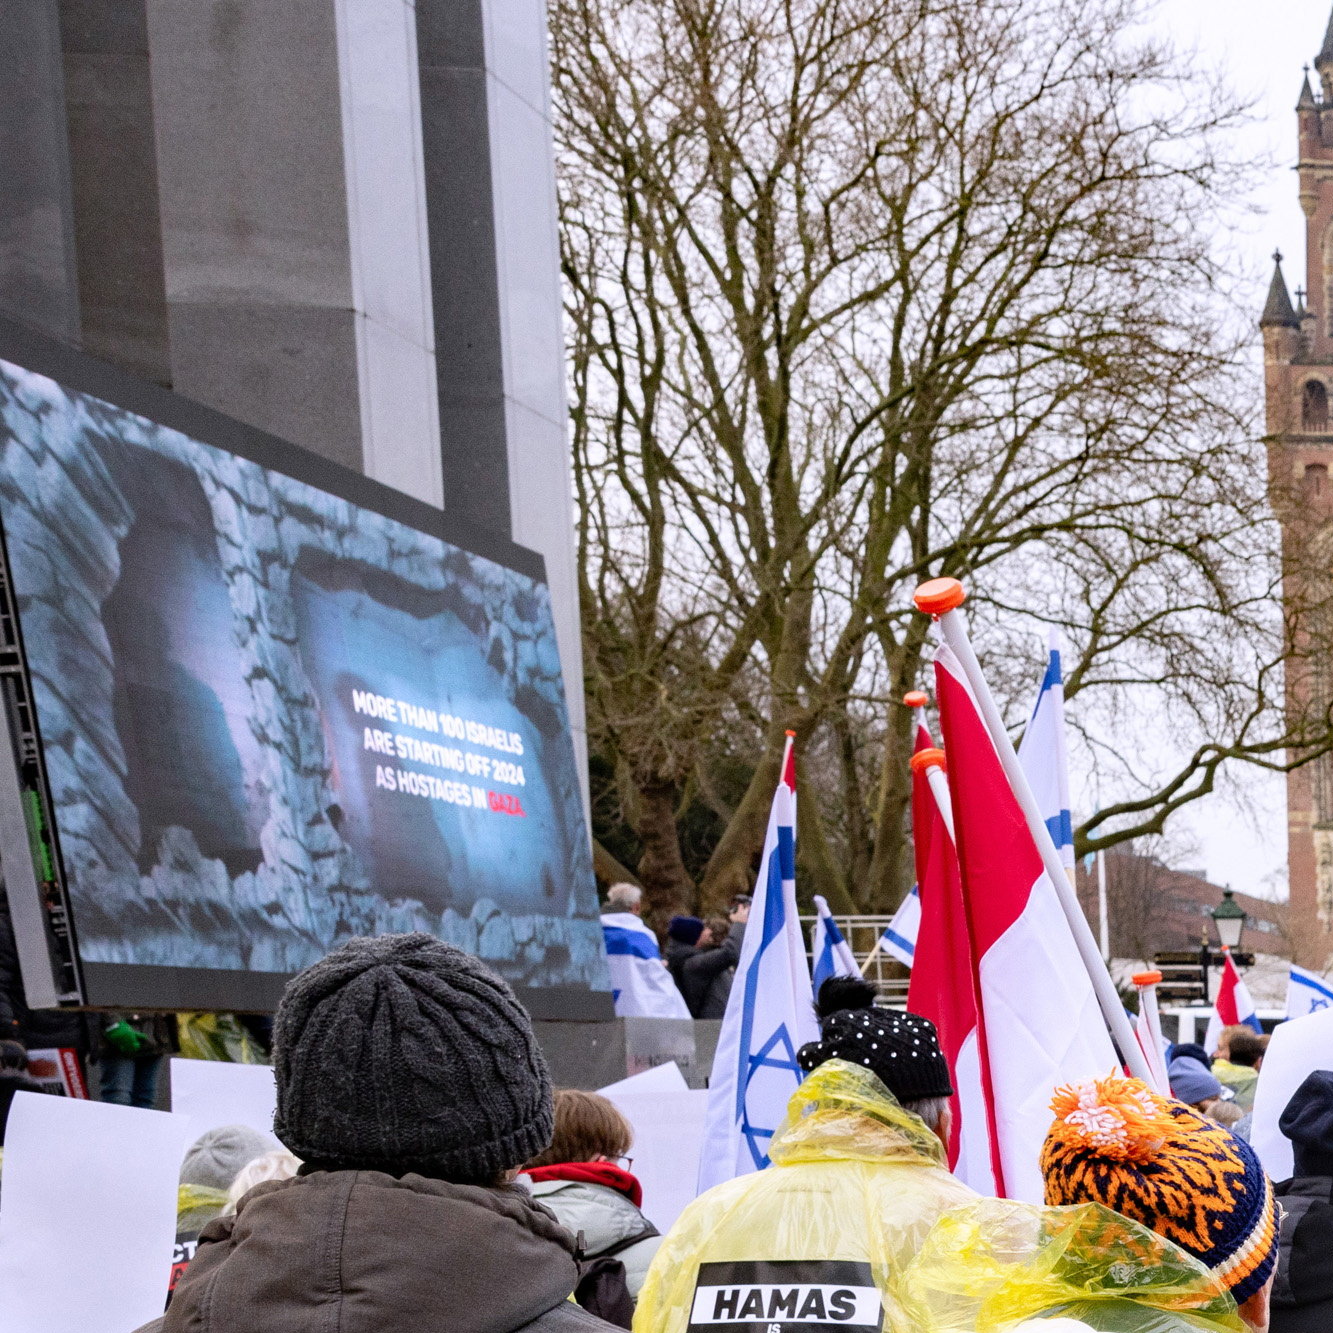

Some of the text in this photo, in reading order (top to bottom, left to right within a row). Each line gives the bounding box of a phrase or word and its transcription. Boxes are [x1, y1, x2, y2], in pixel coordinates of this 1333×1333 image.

[352, 688, 524, 756] MORE THAN 100 ISRAELIS
[364, 727, 526, 786] ARE STARTING OFF 2024
[376, 764, 397, 791] AS
[397, 769, 471, 807] HOSTAGES
[471, 785, 487, 809] IN
[712, 1288, 856, 1320] HAMAS
